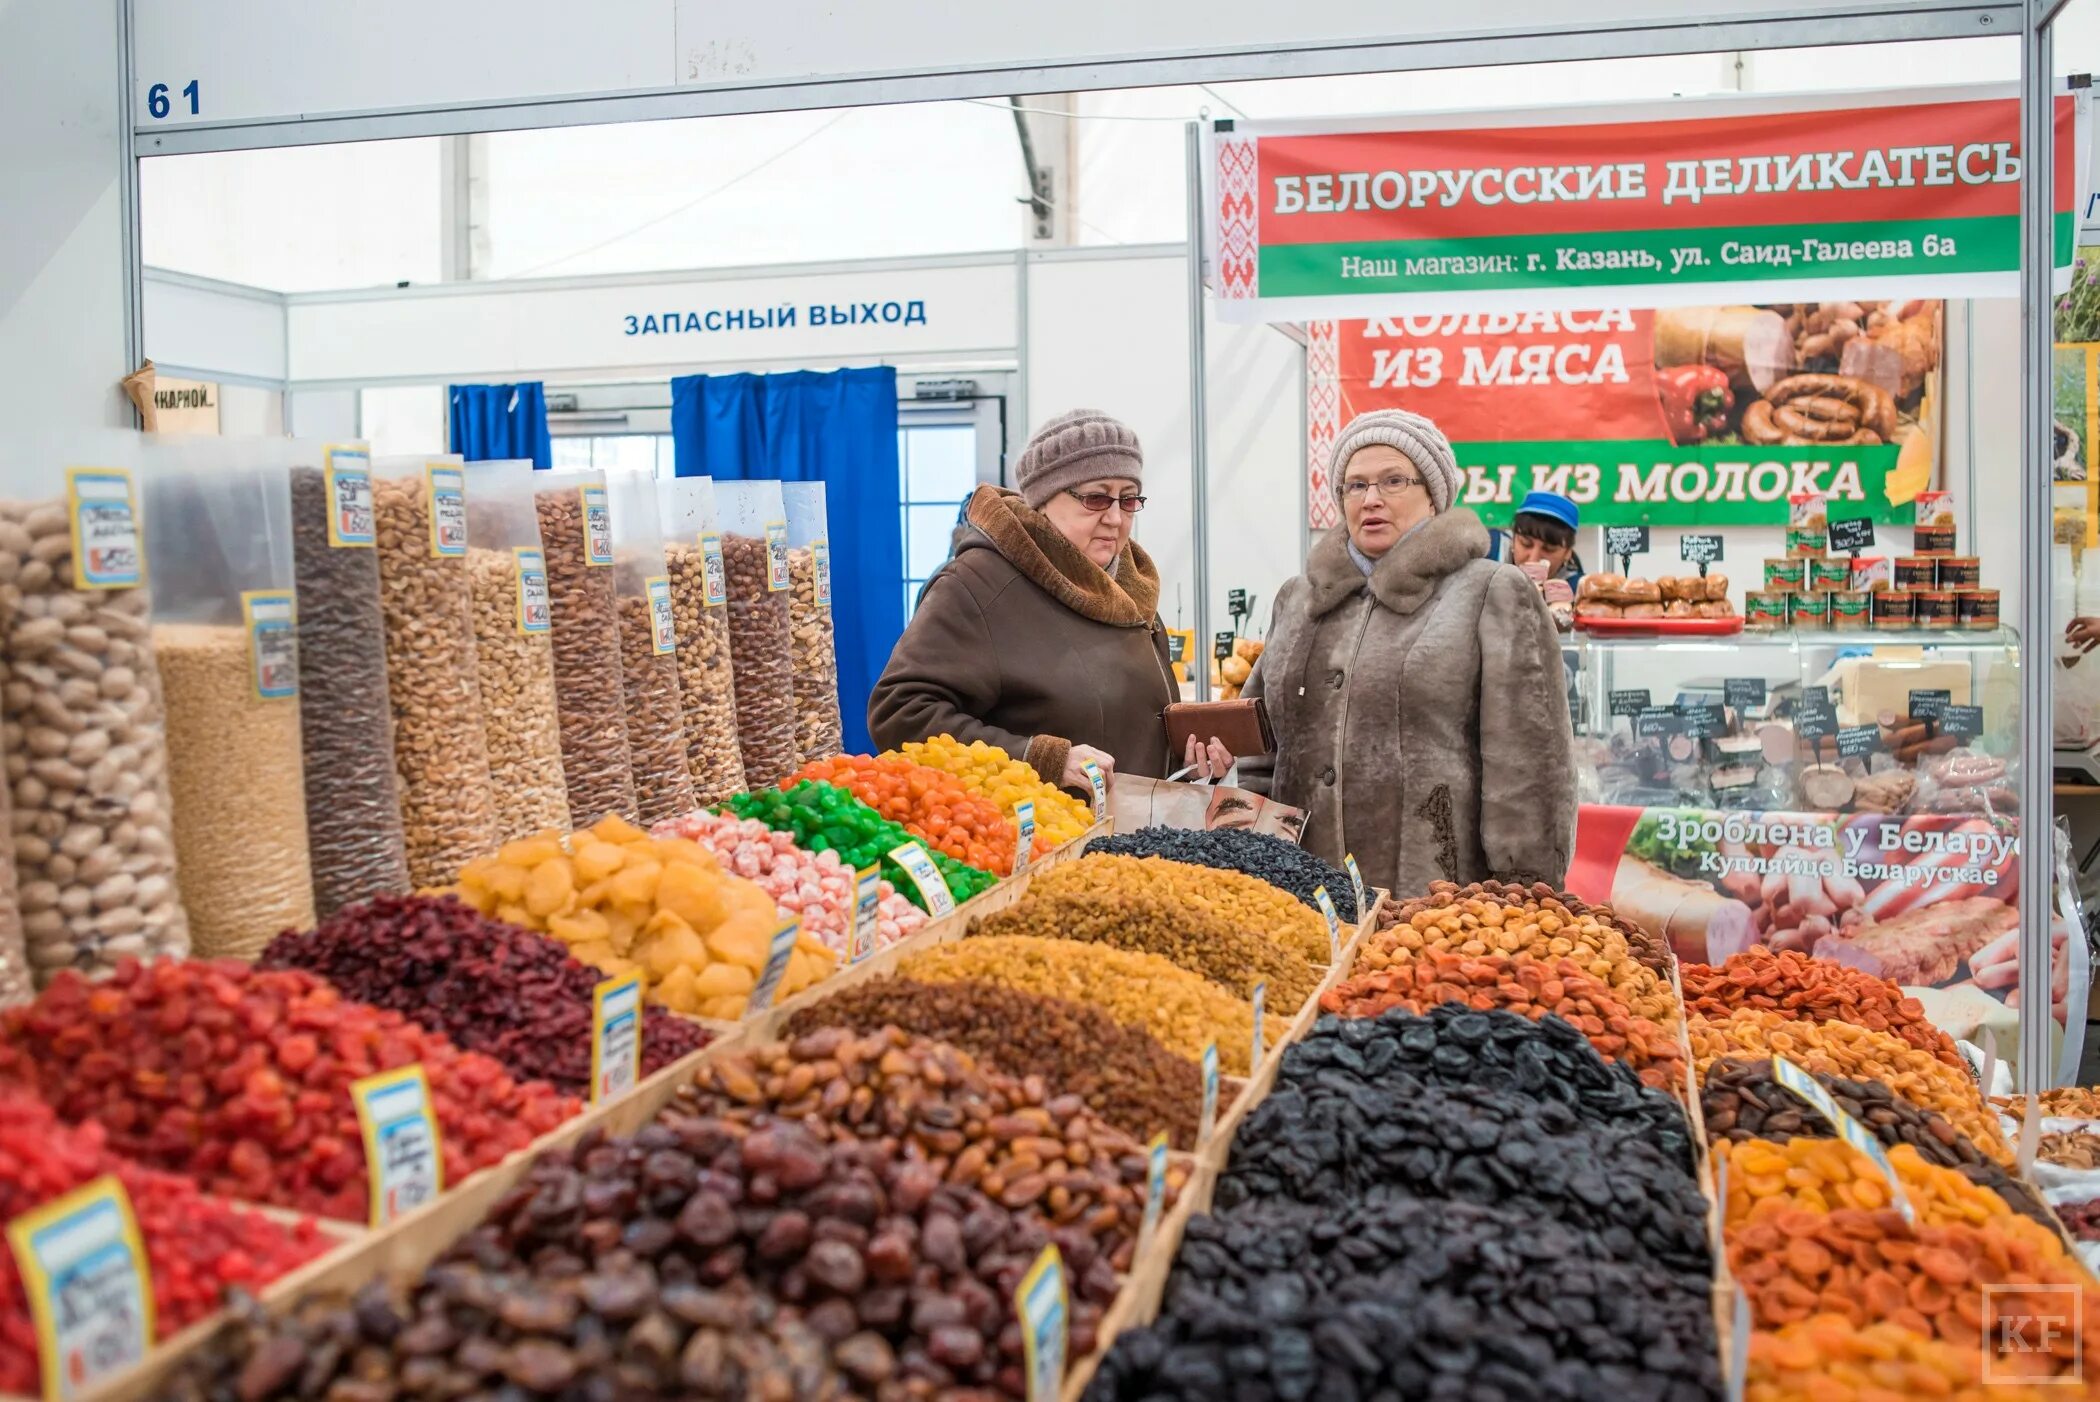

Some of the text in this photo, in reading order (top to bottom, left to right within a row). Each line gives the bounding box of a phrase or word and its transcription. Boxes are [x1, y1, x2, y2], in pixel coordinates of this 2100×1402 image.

[1274, 162, 1647, 214] БЕЛОРУССКИЕ
[1341, 234, 1957, 279] Наш магазин: г. Казань, ул. Саид-Галеева 6а
[623, 299, 927, 336] ЗАПАСНЫЙ ВЫХОД
[1369, 343, 1631, 389] ИЗ МЯСА
[1531, 463, 1602, 504] ИЗ
[1613, 460, 1866, 503] МОЛОКА
[1656, 813, 1836, 850] Зроблена
[1846, 827, 1868, 853] у
[1699, 851, 1998, 889] Купляйце Беларускае
